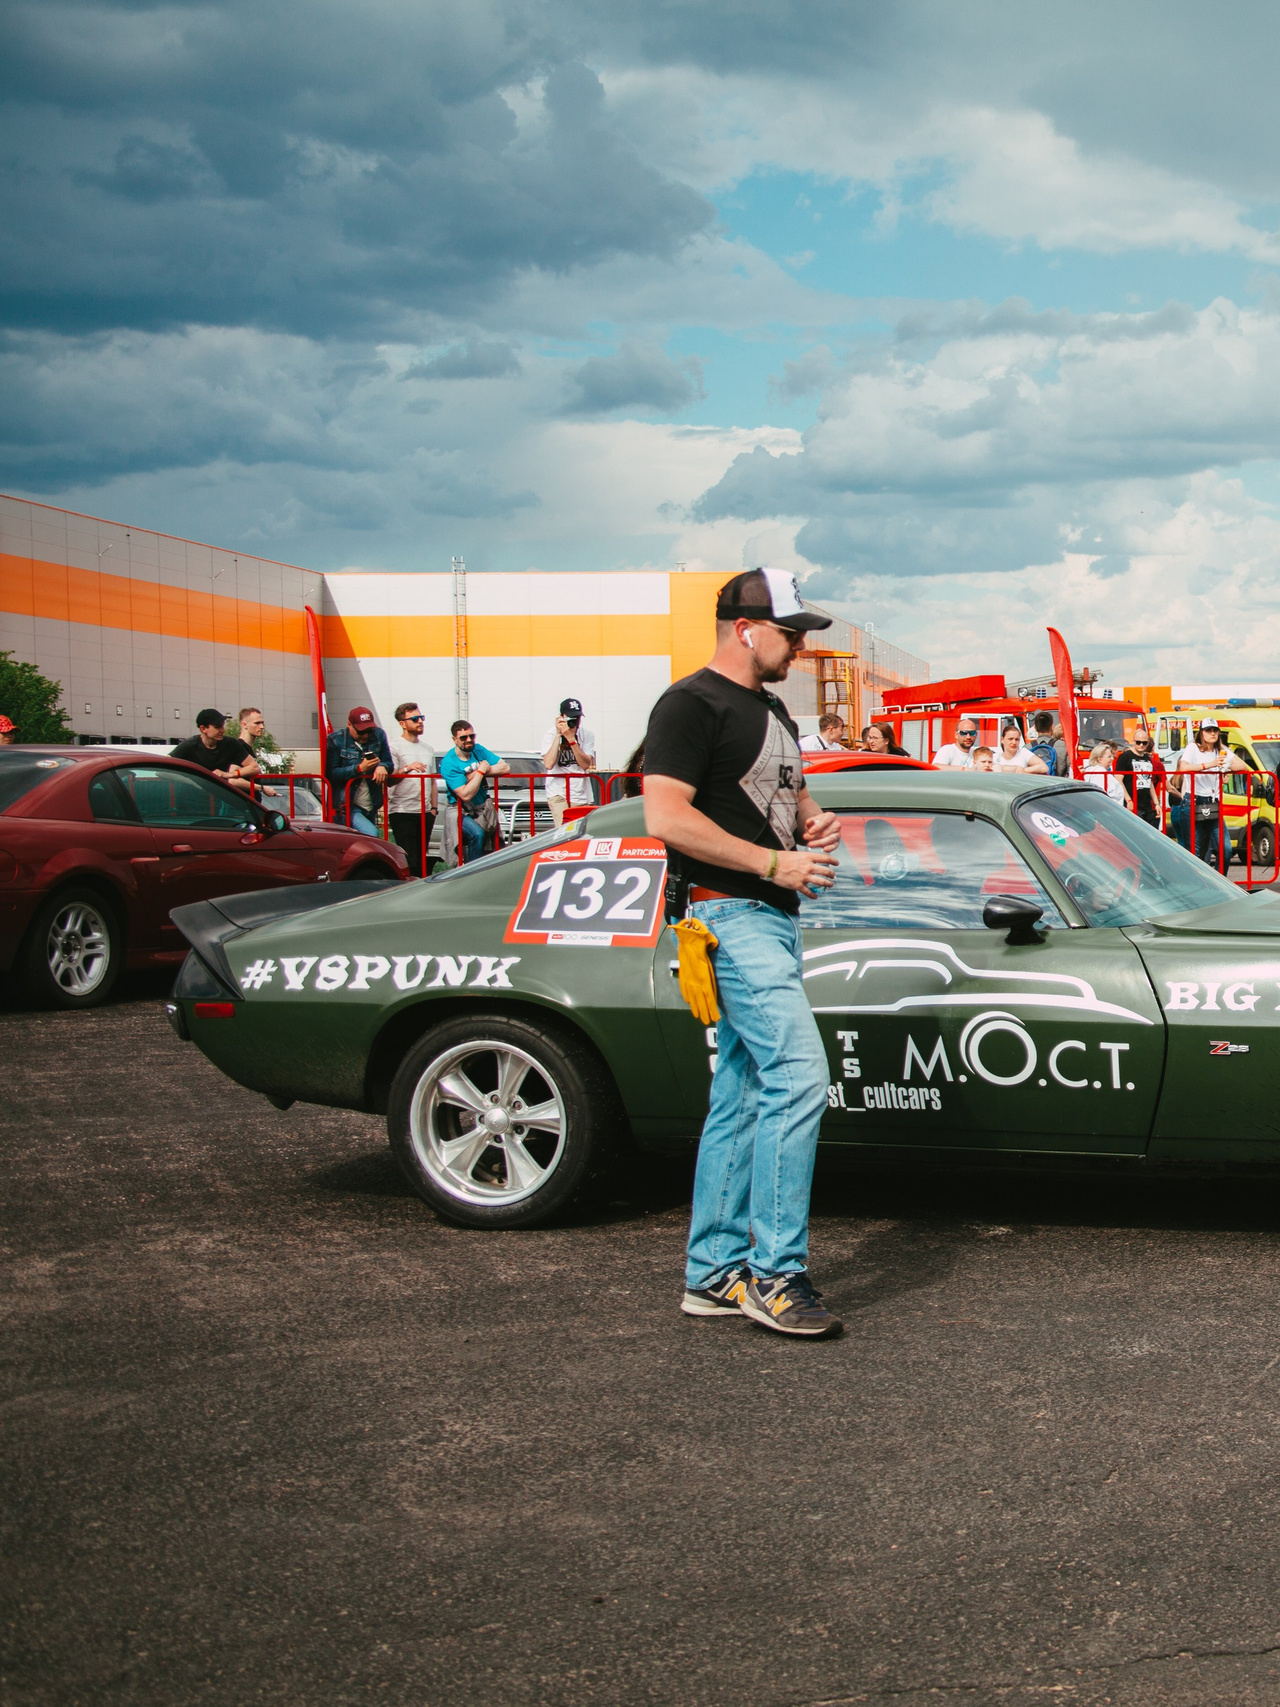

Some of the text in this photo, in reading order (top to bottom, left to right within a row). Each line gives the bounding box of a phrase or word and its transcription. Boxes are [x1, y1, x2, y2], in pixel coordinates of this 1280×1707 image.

[752, 745, 772, 776] QUALITY
[536, 867, 651, 920] 132
[241, 955, 521, 990] #V8PUNK
[1165, 981, 1261, 1011] BIG
[827, 1081, 942, 1111] st_cultcars
